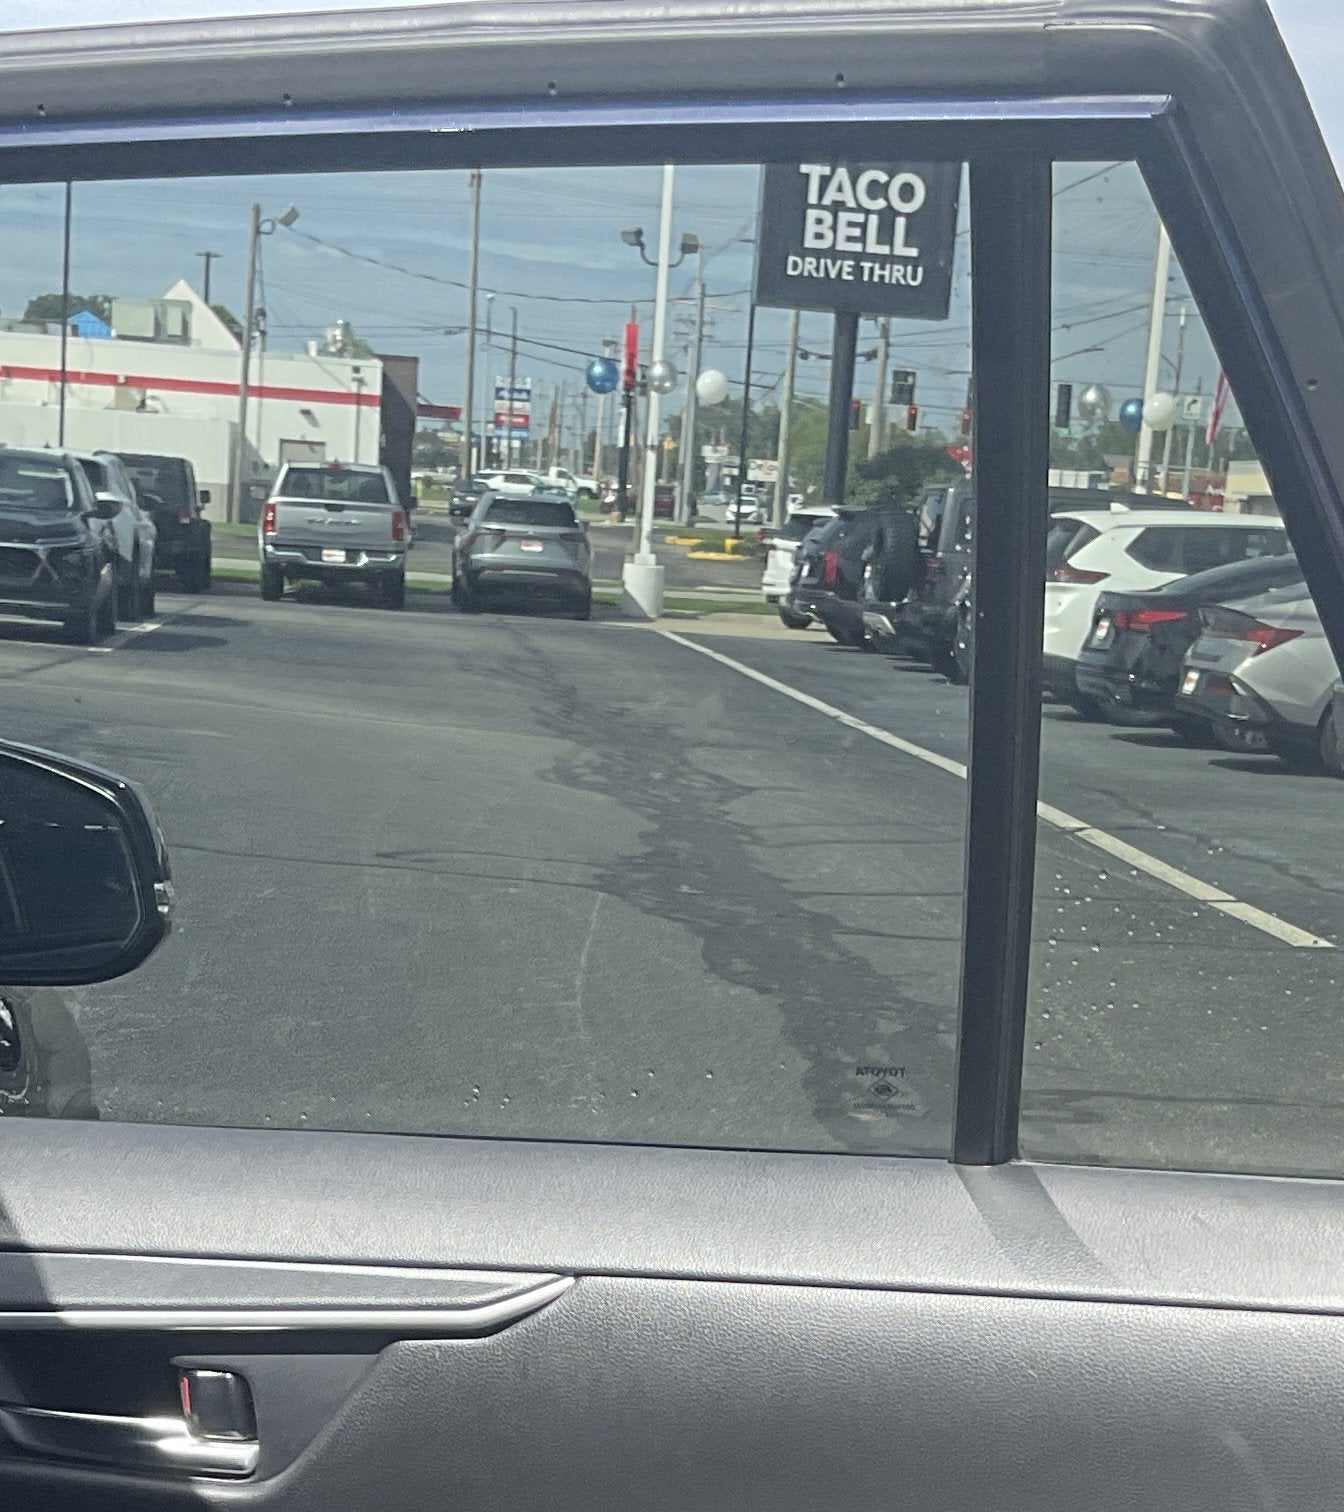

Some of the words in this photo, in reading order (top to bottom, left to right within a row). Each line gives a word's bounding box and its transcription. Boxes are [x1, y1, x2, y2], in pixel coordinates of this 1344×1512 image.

[799, 163, 926, 213] TACO
[803, 208, 919, 257] BELL
[786, 255, 855, 281] DRIVE
[860, 261, 924, 287] THRU
